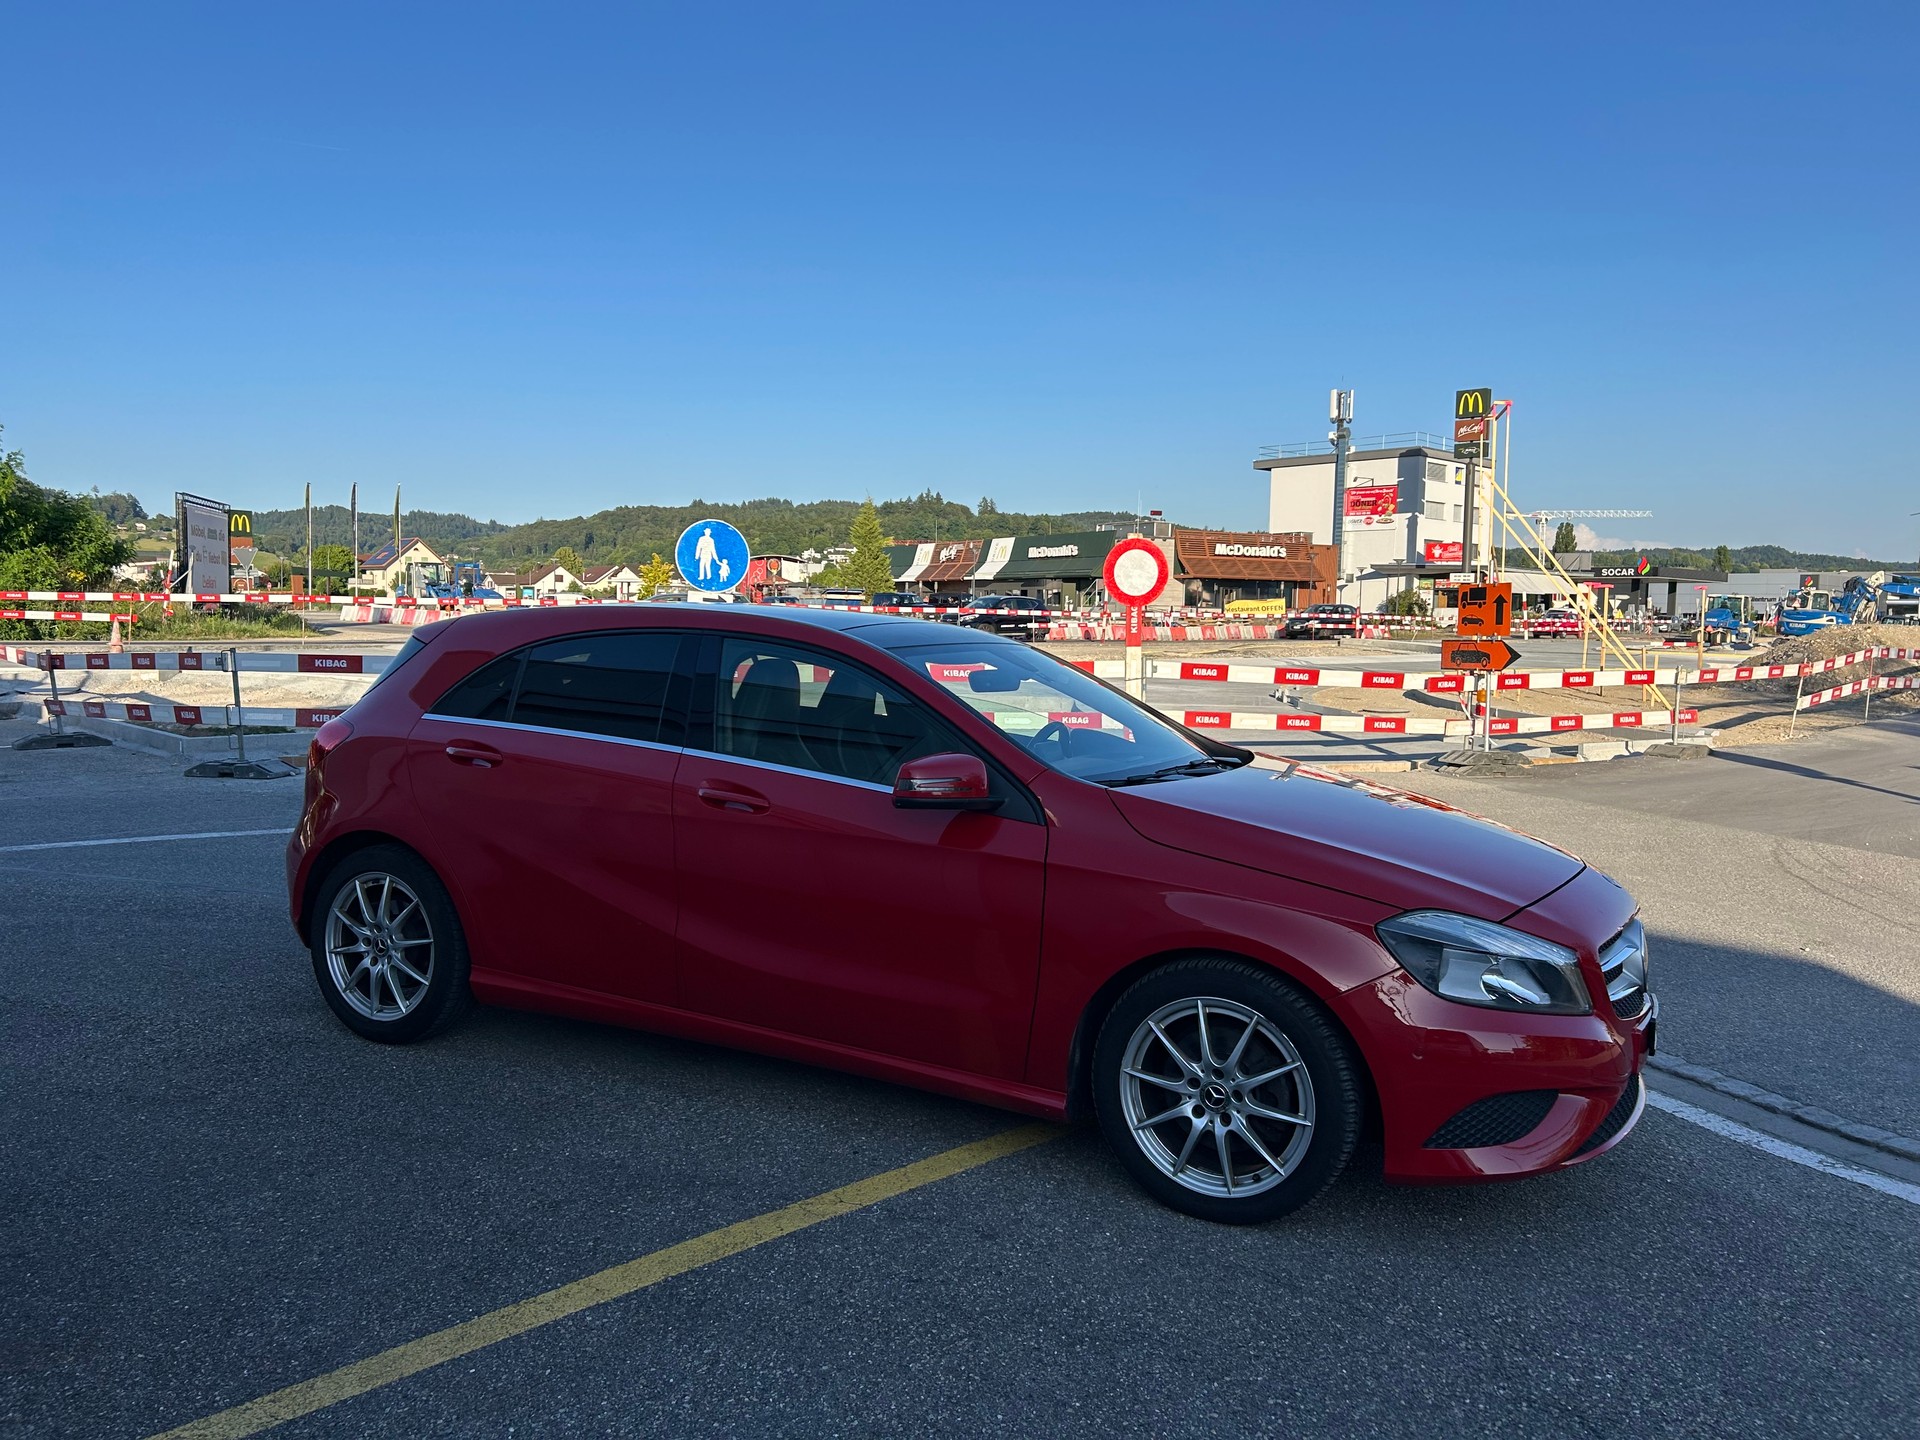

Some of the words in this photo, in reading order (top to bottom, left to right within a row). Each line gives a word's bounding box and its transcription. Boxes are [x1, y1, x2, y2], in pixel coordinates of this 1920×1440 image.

[1028, 544, 1079, 558] McDonald's
[1214, 543, 1287, 558] McDonald's
[1601, 568, 1635, 576] SOCAR
[1261, 604, 1284, 612] OFFEN
[1130, 606, 1138, 634] KIBAG
[314, 659, 348, 668] KIBAG
[1192, 667, 1218, 677] KIBAG
[1285, 672, 1310, 681] KIBAG
[1372, 676, 1395, 684] KIBAG
[312, 714, 337, 722] KIBA
[1062, 716, 1089, 724] KIBAG
[1195, 716, 1220, 724] KIBAG
[1619, 715, 1636, 723] KIBAG
[1286, 719, 1310, 727] KIBAG
[1373, 721, 1396, 729] KIBAG
[1491, 722, 1510, 730] KIBAG
[1558, 719, 1576, 727] KIBAG
